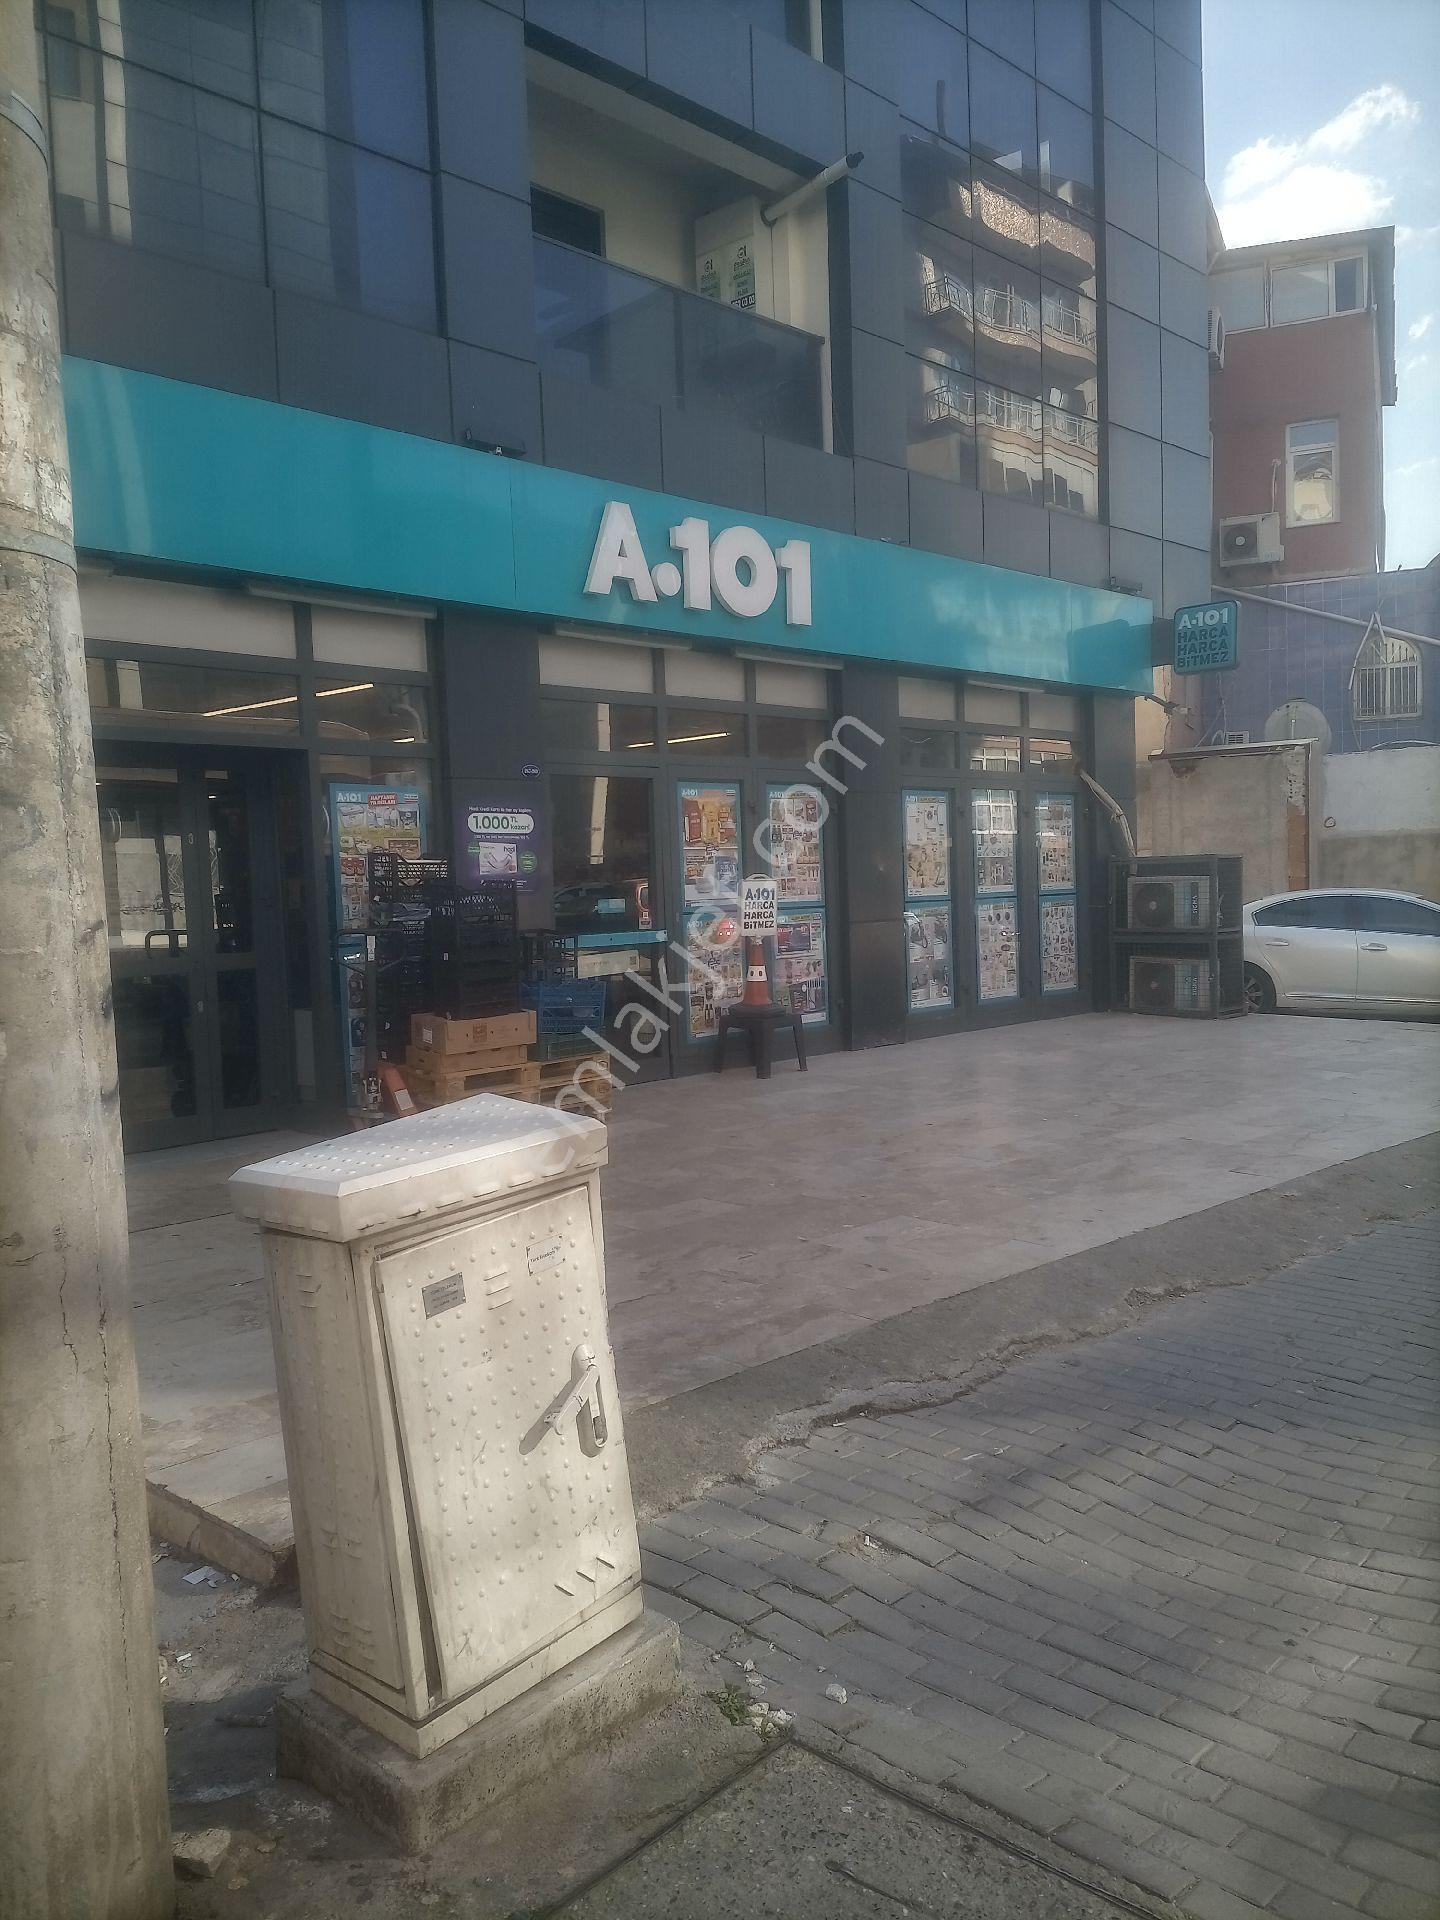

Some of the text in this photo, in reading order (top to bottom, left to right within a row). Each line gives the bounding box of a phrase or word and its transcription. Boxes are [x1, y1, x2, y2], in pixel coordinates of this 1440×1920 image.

[583, 500, 812, 626] A.101
[1177, 626, 1229, 643] HARCA
[1177, 639, 1229, 656] HARCA
[473, 815, 510, 830] 1.000
[744, 901, 775, 910] HARCA
[744, 911, 775, 919] HARCA
